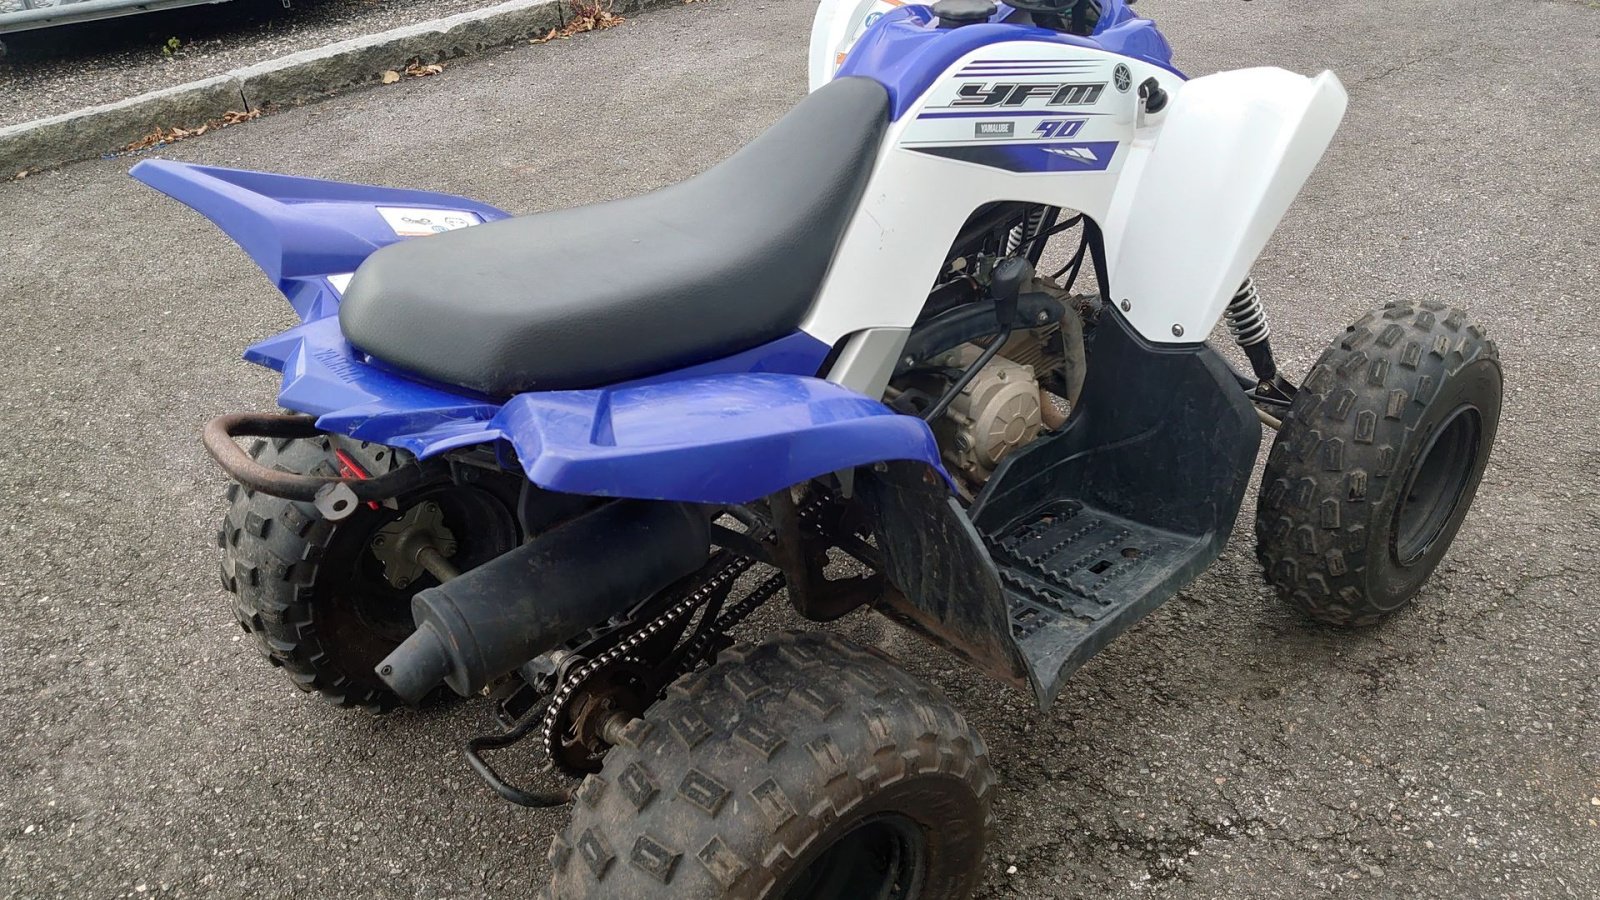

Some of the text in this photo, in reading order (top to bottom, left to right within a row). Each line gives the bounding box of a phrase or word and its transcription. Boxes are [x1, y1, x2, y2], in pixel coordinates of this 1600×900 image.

[950, 81, 1108, 107] YFM
[980, 123, 1009, 133] YAMALUBE
[1033, 119, 1087, 139] 90
